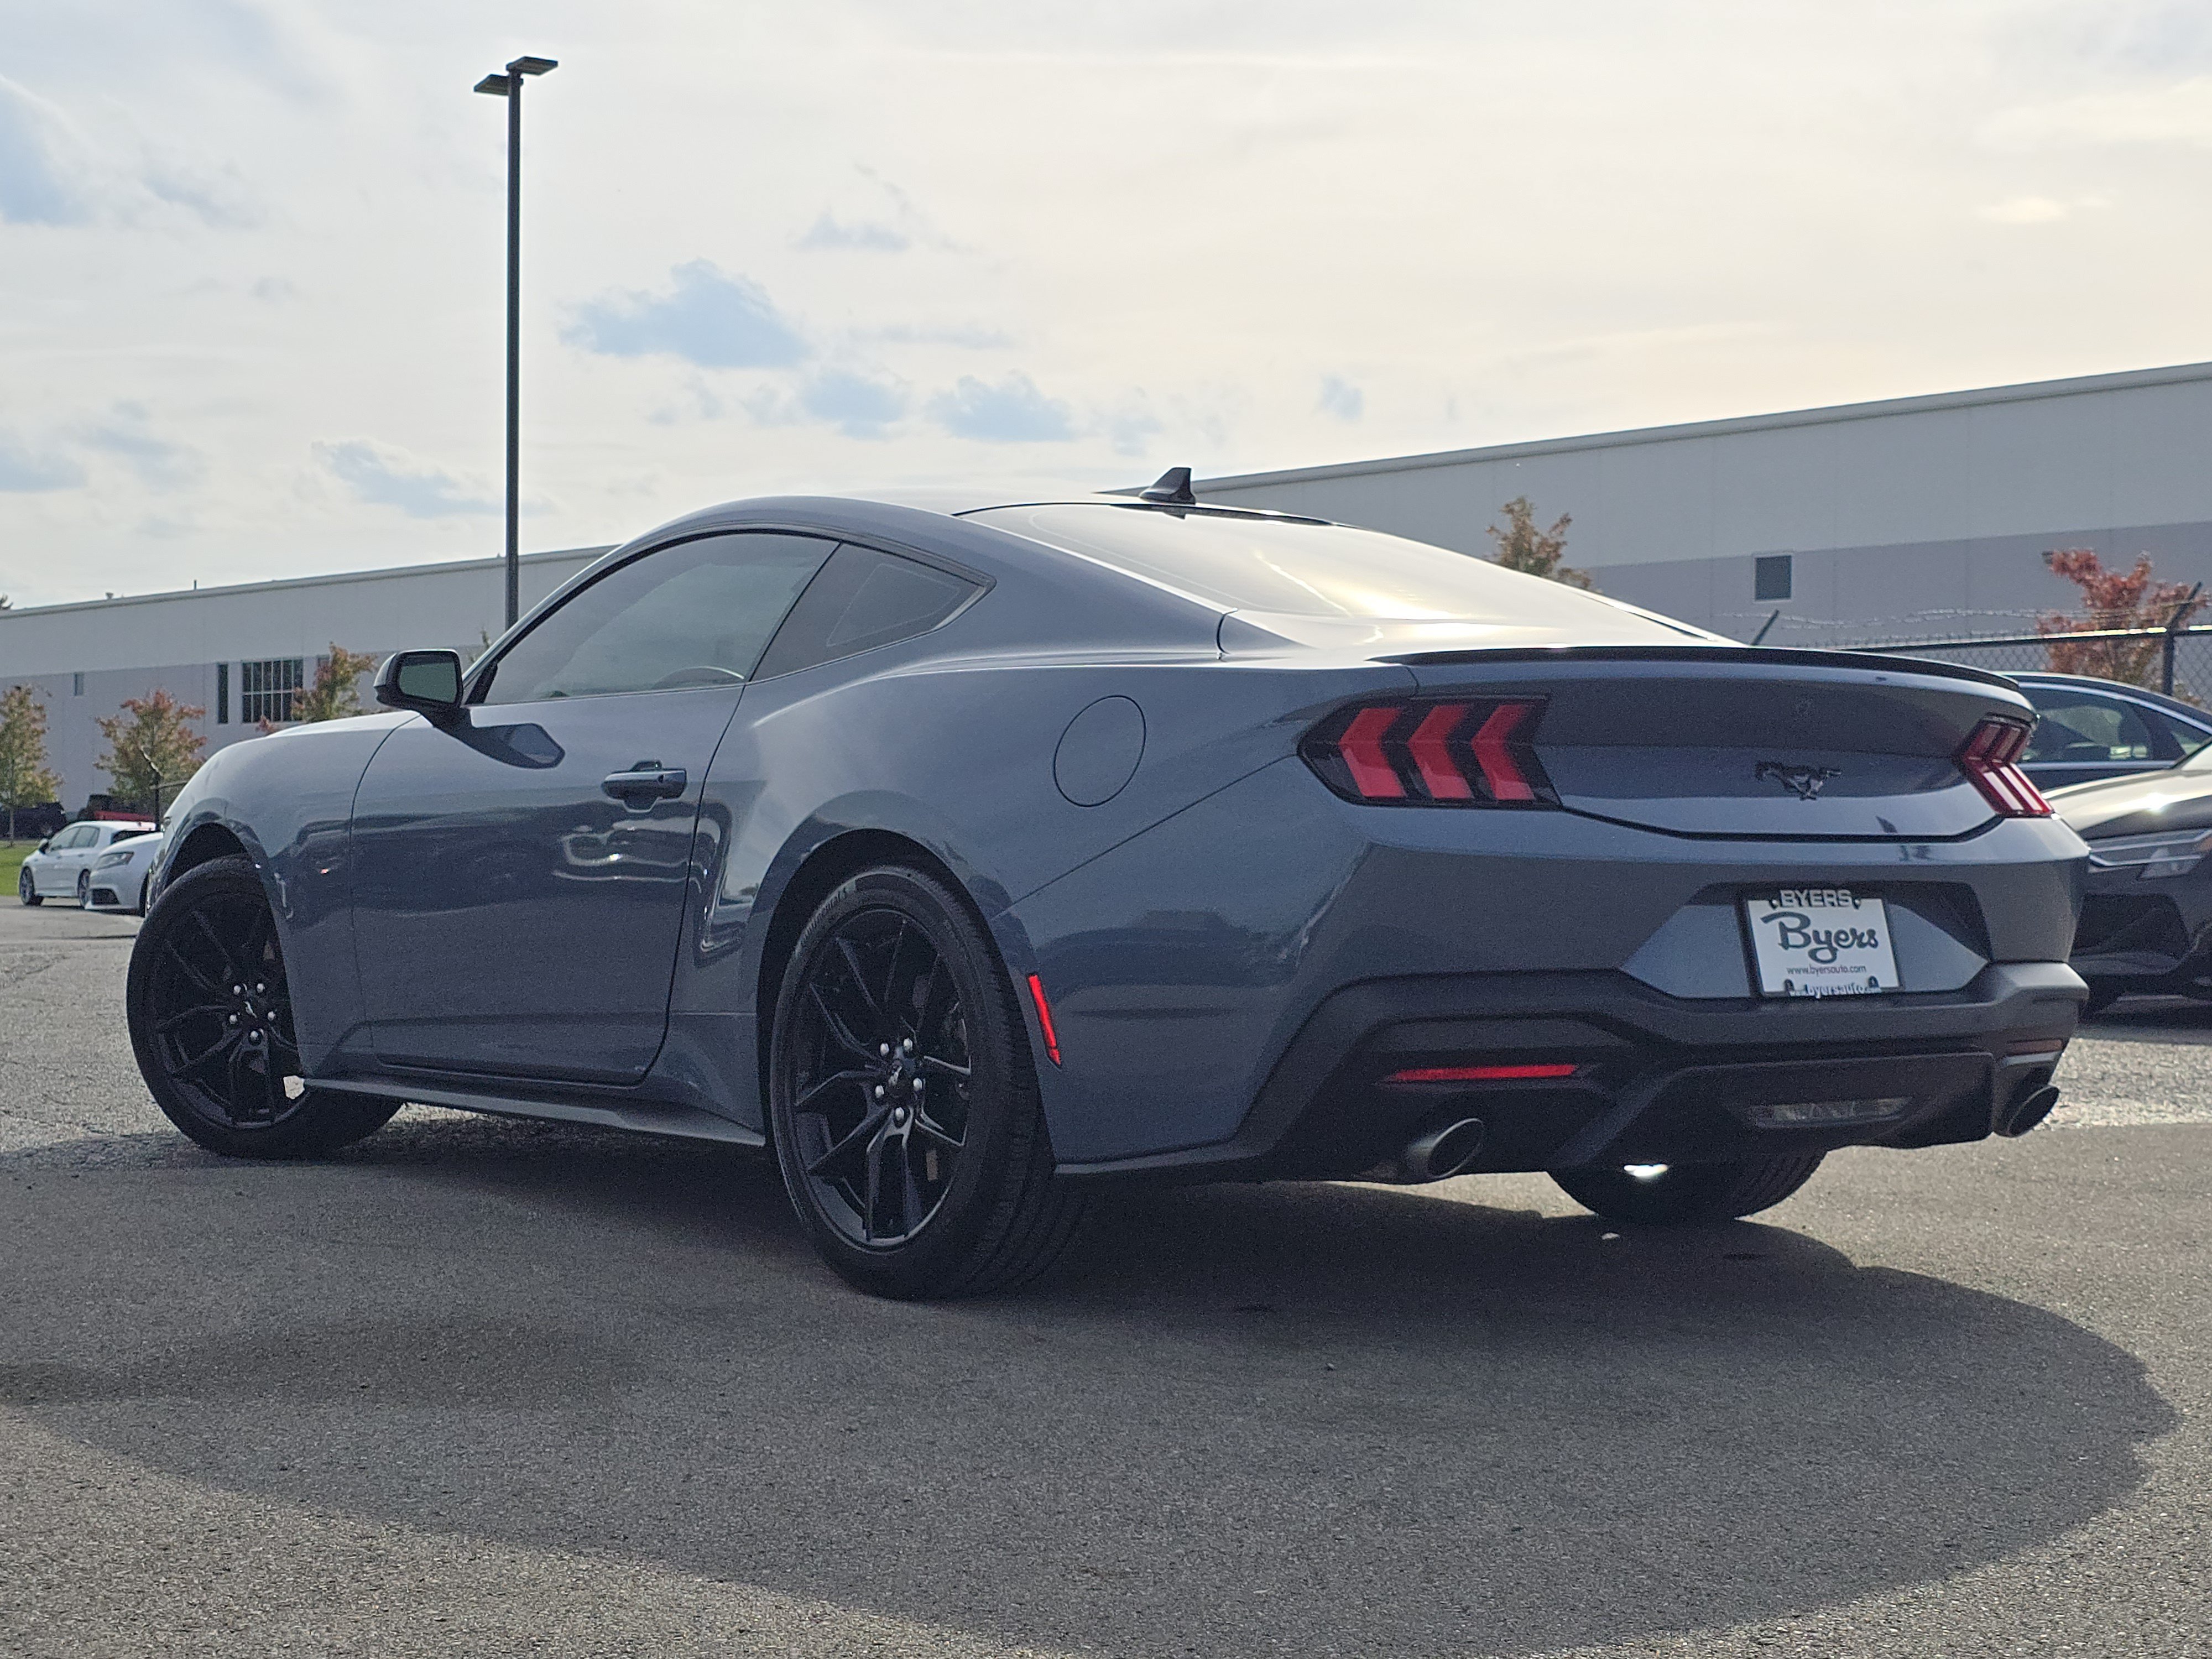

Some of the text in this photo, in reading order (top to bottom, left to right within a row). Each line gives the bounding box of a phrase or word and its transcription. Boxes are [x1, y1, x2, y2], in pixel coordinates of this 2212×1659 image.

[1780, 889, 1853, 907] BYERS
[1760, 911, 1879, 964] Byers
[1786, 964, 1866, 977] www.byersauto.com
